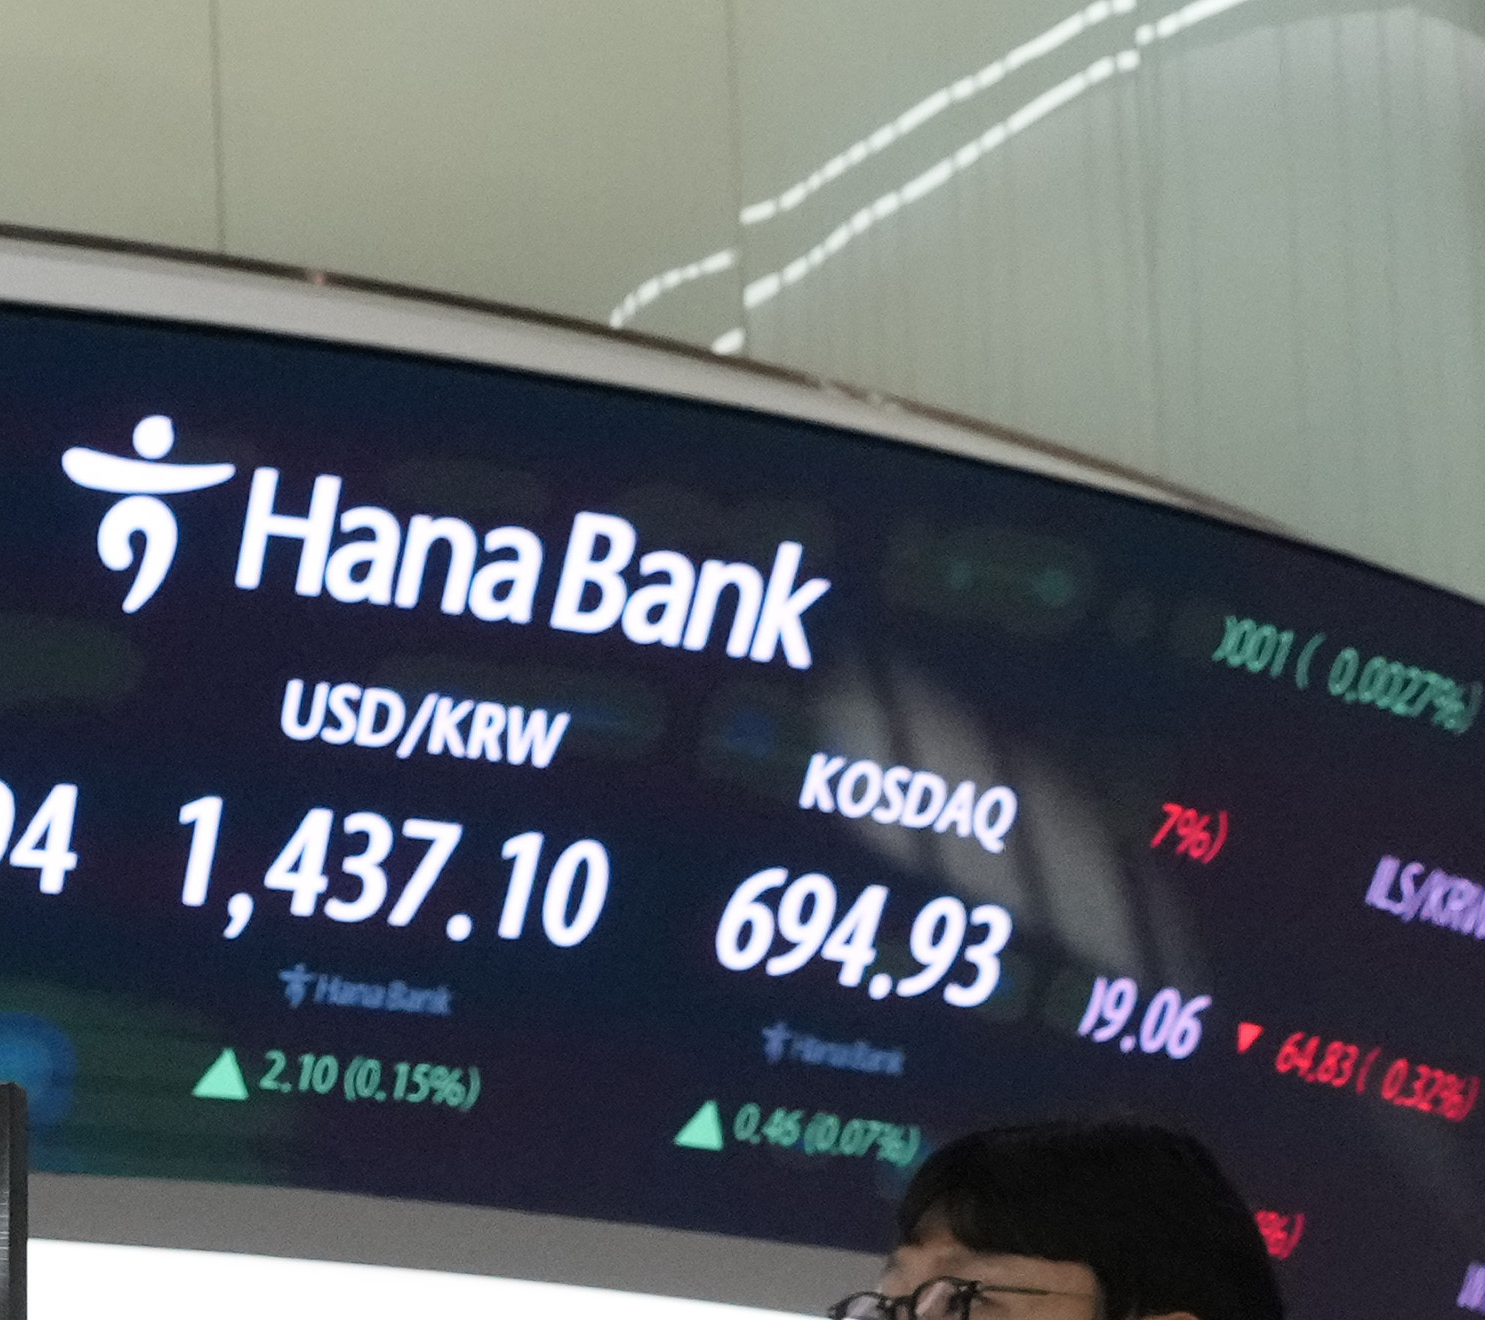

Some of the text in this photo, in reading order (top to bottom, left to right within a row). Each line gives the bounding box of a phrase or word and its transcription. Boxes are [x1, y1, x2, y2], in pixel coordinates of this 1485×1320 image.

[280, 678, 572, 769] USD/KRW
[798, 751, 1018, 855] KOSDAQ
[178, 795, 611, 948] 1,437.10
[715, 866, 1013, 1008] 694.93
[259, 1050, 481, 1109] 2.10 (0.15%)
